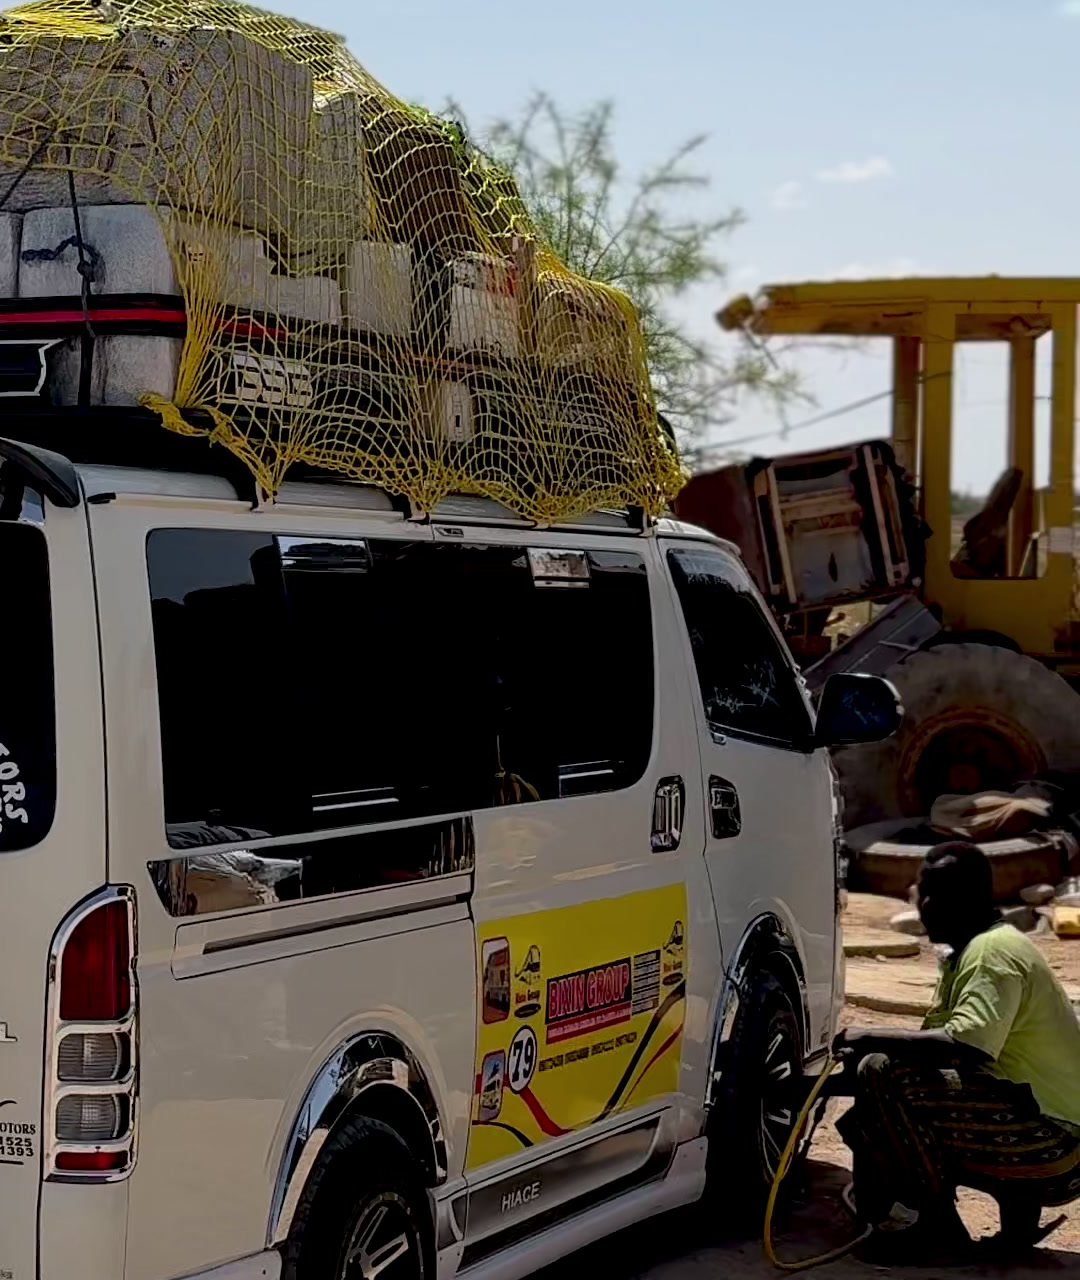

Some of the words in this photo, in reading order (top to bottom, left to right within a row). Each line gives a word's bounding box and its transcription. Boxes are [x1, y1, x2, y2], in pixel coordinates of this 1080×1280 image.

[586, 962, 630, 1009] GROUP
[512, 1036, 535, 1083] 79
[502, 1181, 541, 1213] HIACE
